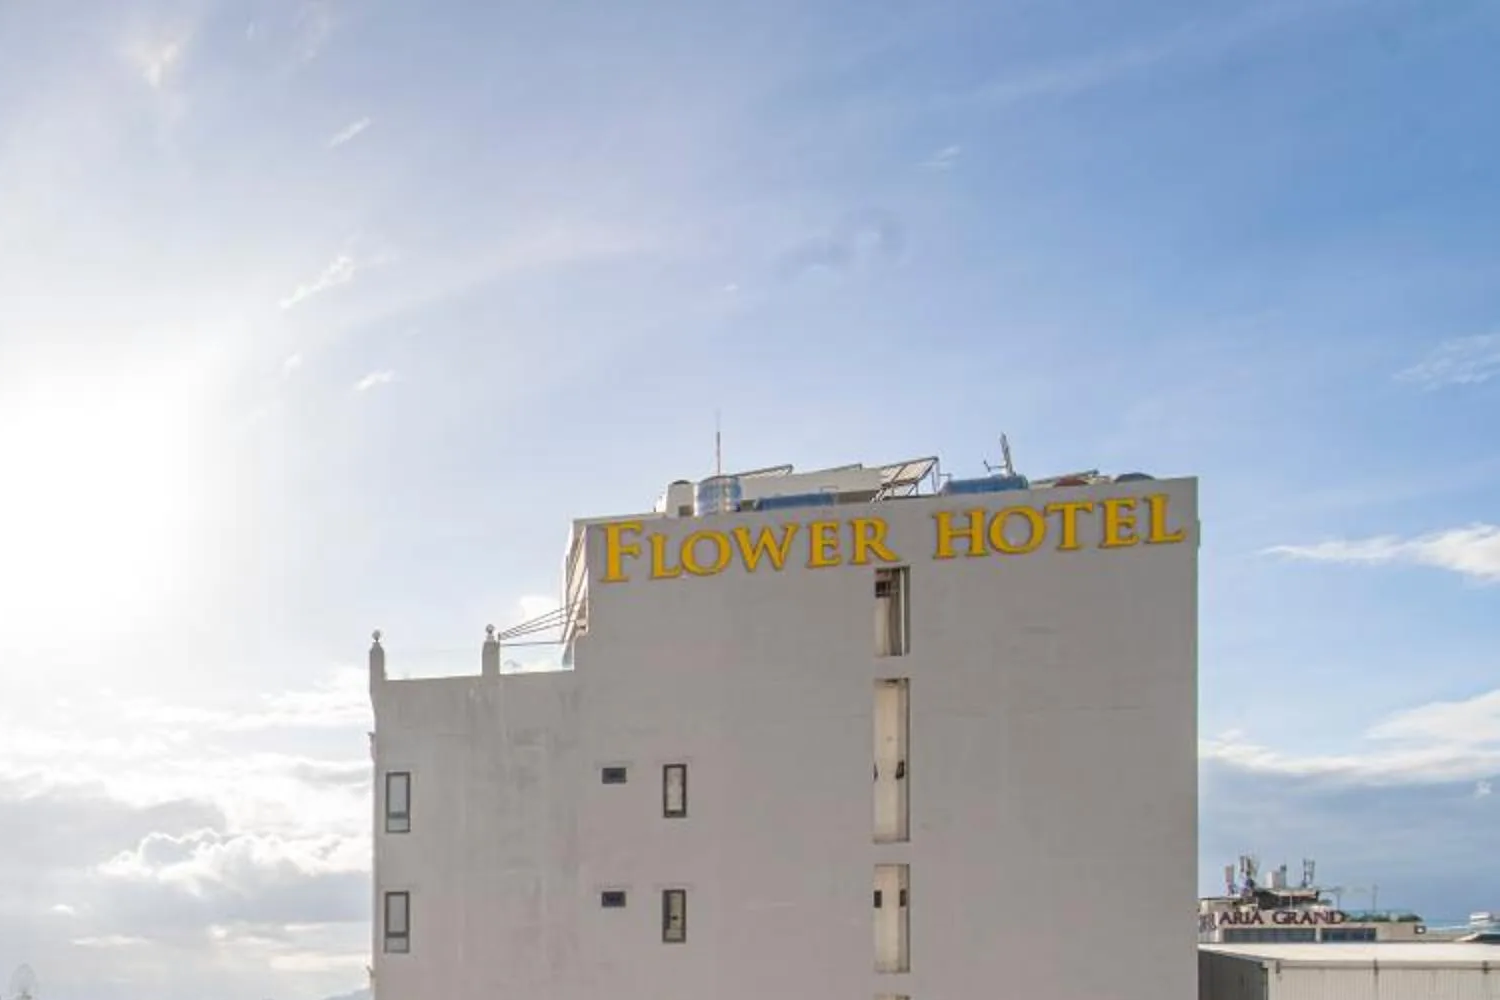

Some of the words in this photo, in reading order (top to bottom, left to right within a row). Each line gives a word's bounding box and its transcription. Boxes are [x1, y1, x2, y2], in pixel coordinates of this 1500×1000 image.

[600, 519, 902, 584] FLOWER
[932, 493, 1188, 560] HOTEL
[1219, 911, 1264, 925] ARIA
[1271, 911, 1345, 925] GRAND
